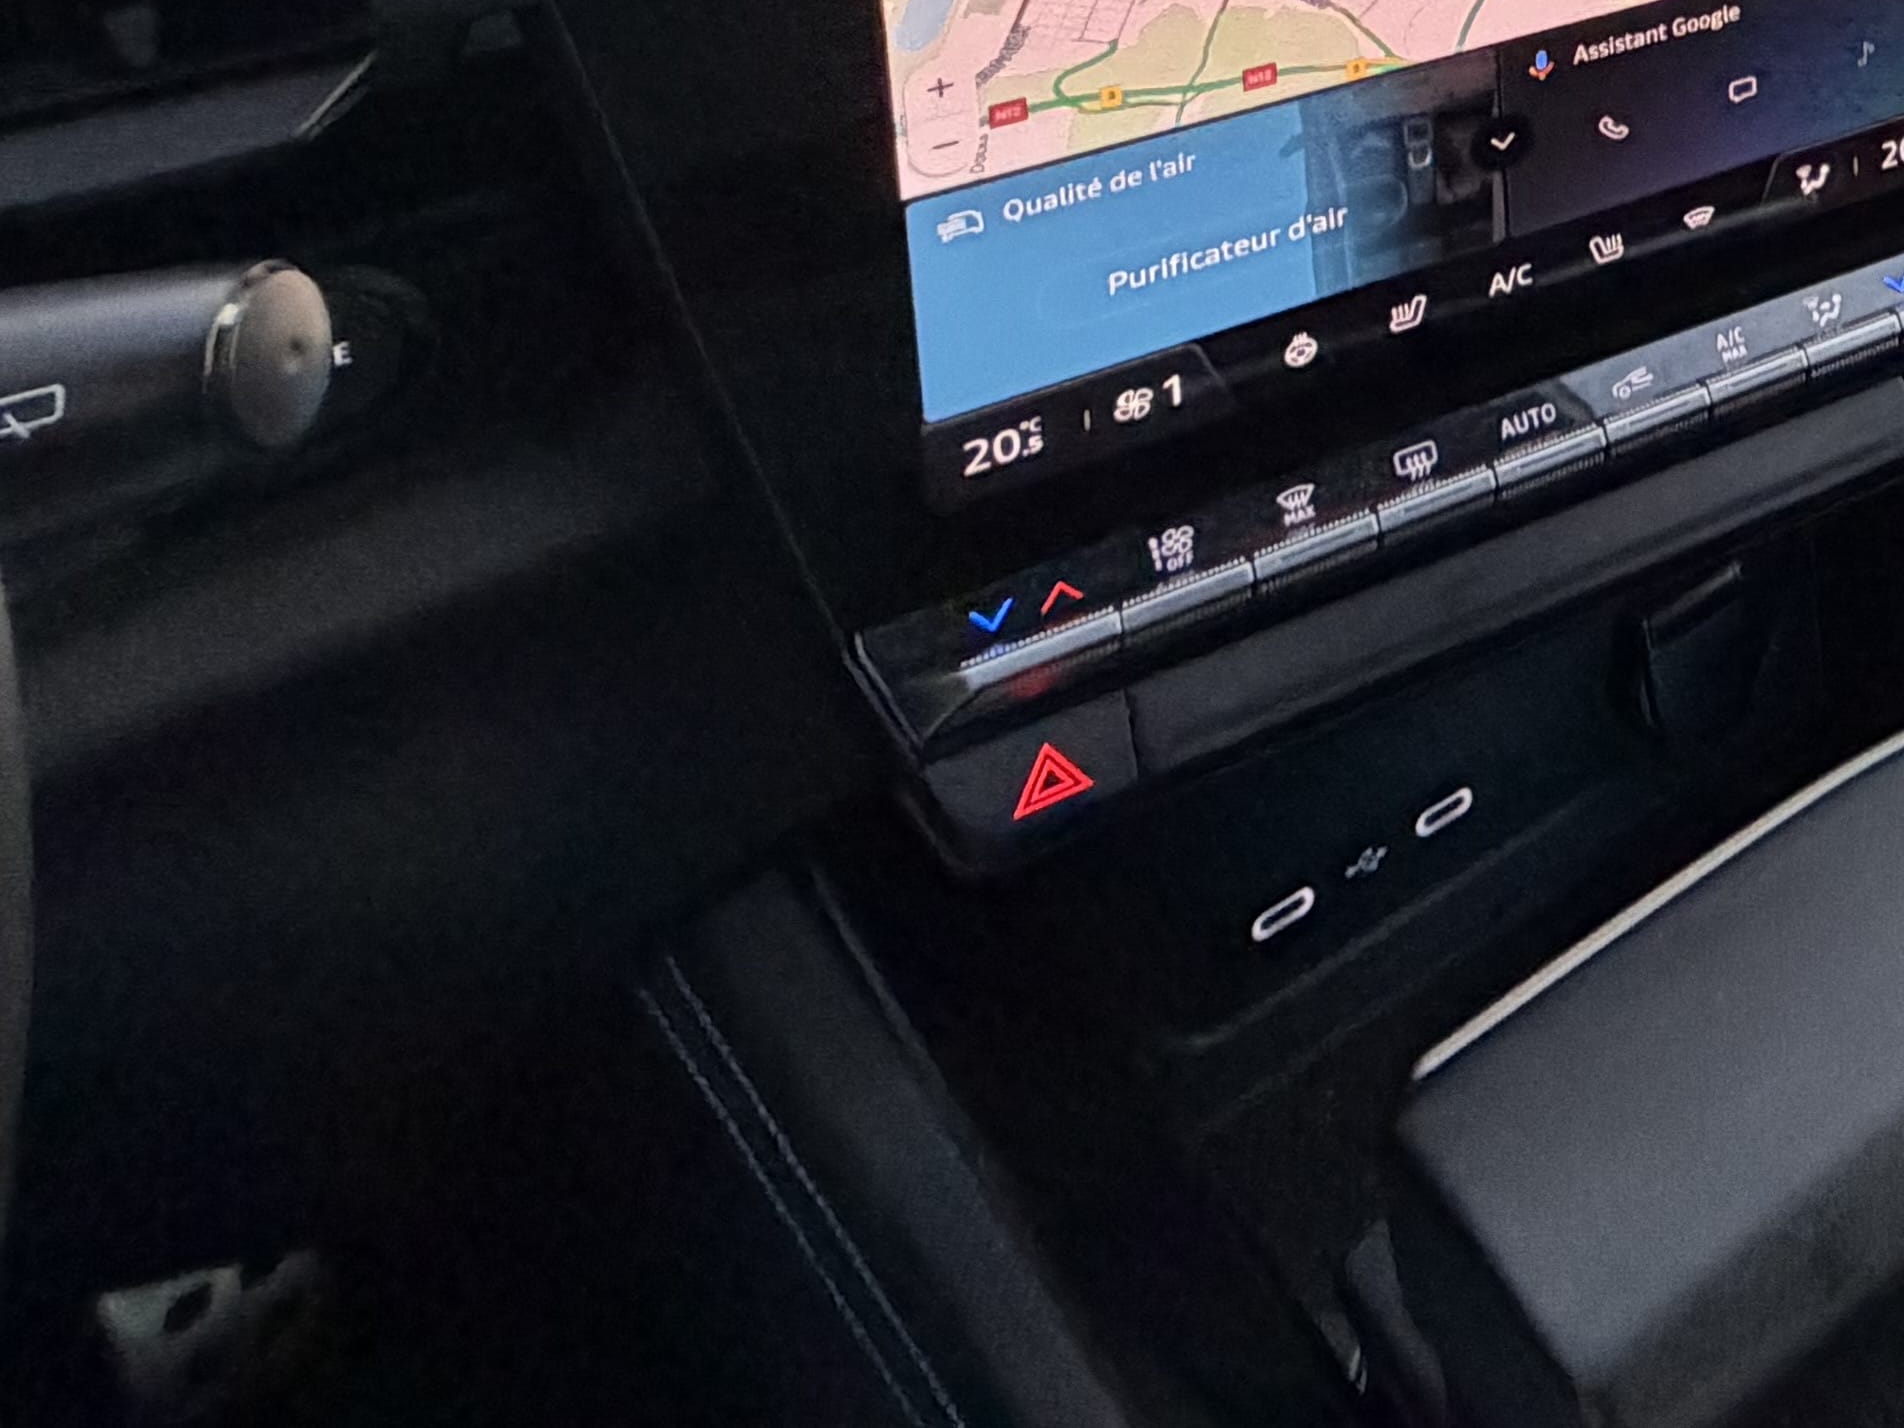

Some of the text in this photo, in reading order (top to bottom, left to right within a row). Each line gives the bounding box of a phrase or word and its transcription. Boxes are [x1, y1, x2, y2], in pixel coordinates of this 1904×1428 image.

[1573, 2, 1742, 67] Assistant Google
[1002, 151, 1198, 224] Qualité de l'air
[1107, 205, 1350, 297] Purificateur d'air
[1488, 263, 1534, 298] A/C
[1716, 326, 1745, 350] A/C
[1162, 373, 1183, 408] 1
[1500, 401, 1557, 441] AUTO
[1283, 503, 1317, 527] MAX
[1166, 550, 1195, 573] OFF
